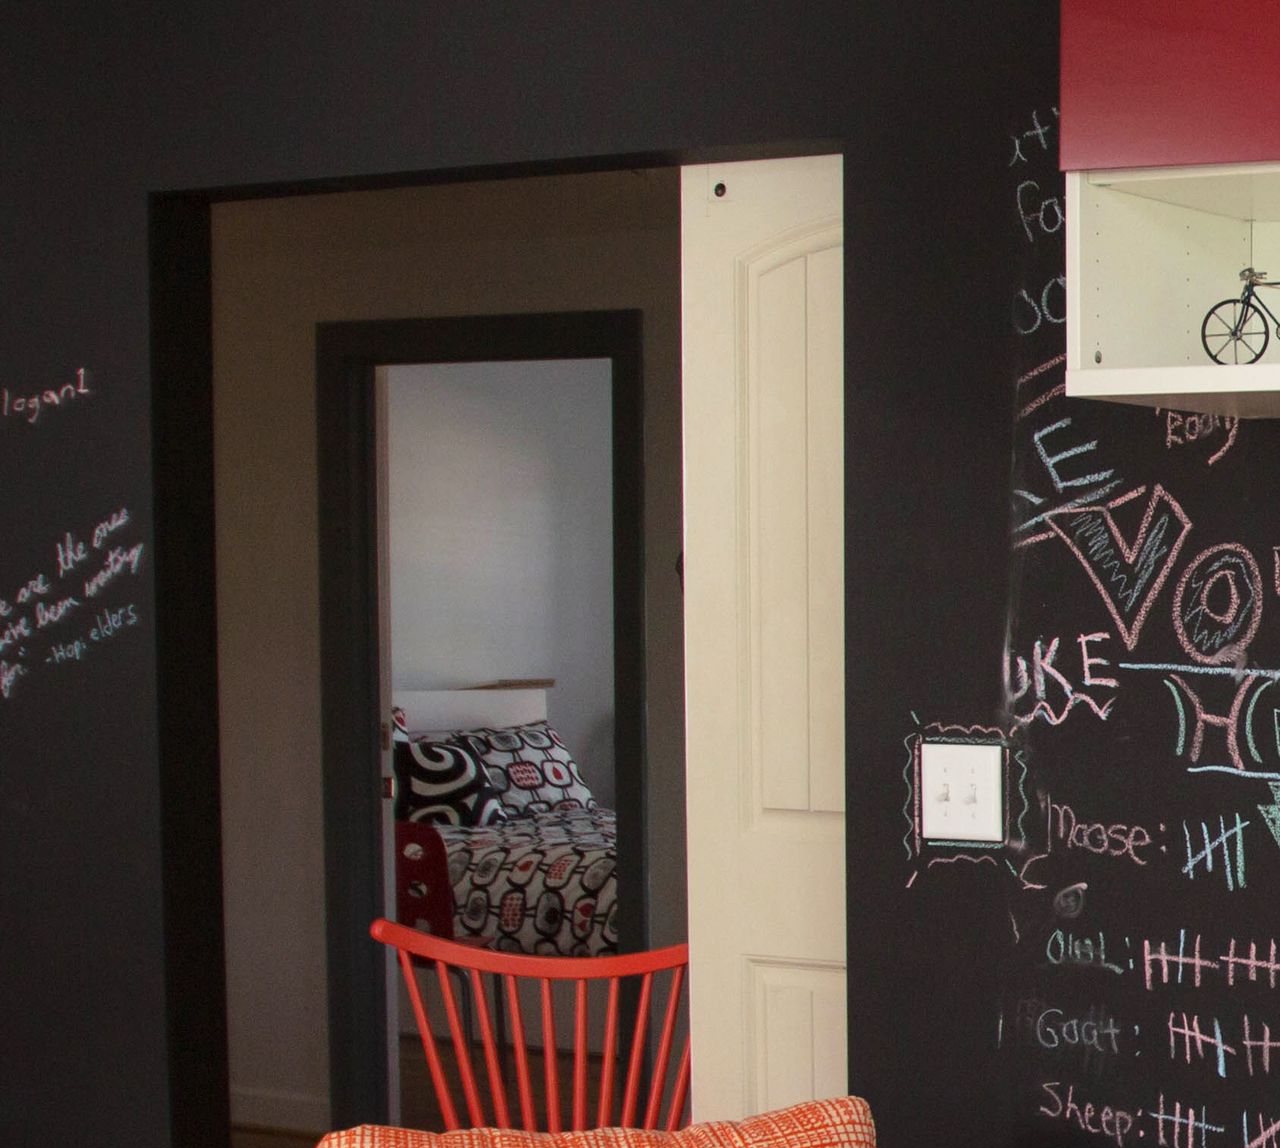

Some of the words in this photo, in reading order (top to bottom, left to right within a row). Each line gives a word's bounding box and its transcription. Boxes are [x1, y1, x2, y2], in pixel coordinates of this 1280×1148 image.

[57, 532, 88, 578] the
[92, 507, 130, 549] ones
[89, 604, 138, 641] elders
[1040, 1082, 1145, 1148] Sheep:
